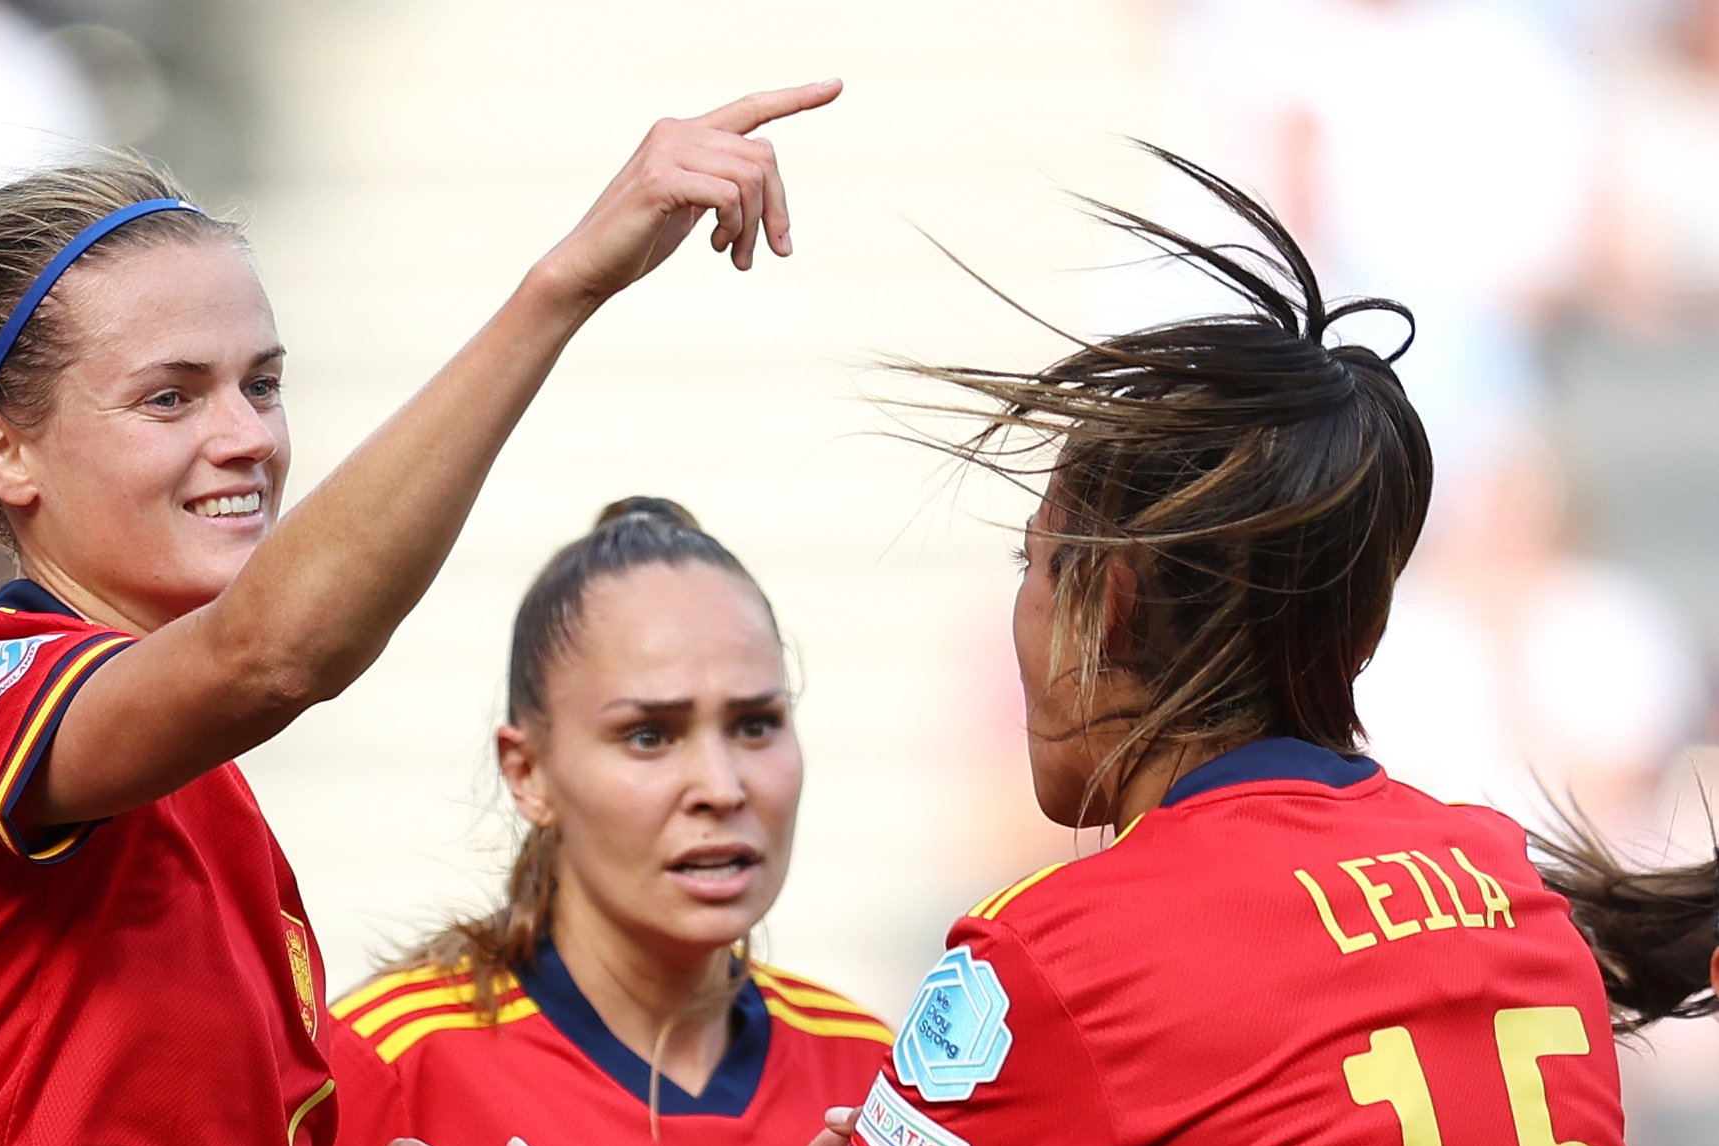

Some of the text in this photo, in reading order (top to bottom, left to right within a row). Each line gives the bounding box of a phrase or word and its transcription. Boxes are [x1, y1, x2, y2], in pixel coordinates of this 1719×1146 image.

[1293, 847, 1516, 954] LEILA
[935, 988, 950, 1010] We
[919, 1020, 959, 1060] Strong
